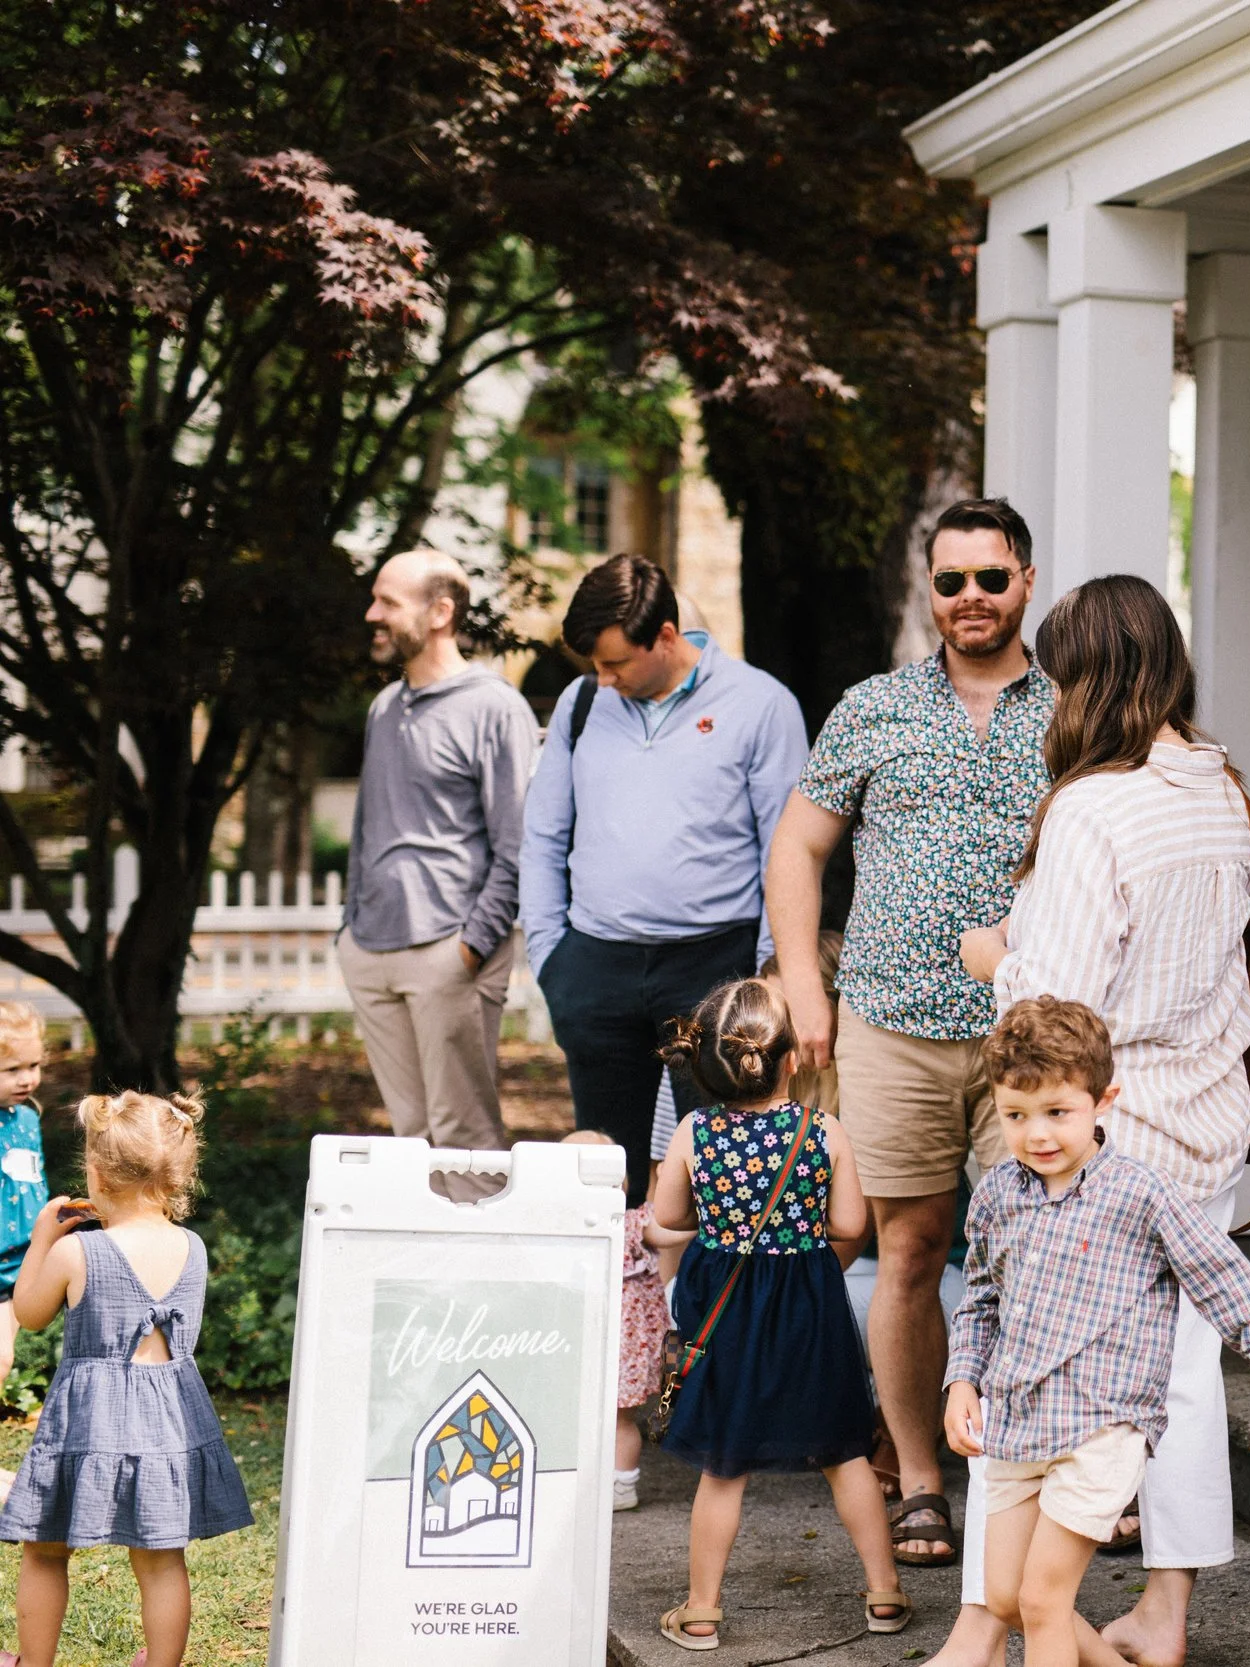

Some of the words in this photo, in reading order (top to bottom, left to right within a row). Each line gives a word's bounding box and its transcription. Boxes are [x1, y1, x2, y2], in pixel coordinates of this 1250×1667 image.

[388, 1299, 571, 1377] Welcome.
[414, 1602, 467, 1615] WE'RE
[470, 1602, 518, 1615] GLAD
[411, 1622, 471, 1635] YOU'RE
[475, 1622, 520, 1635] HERE.
